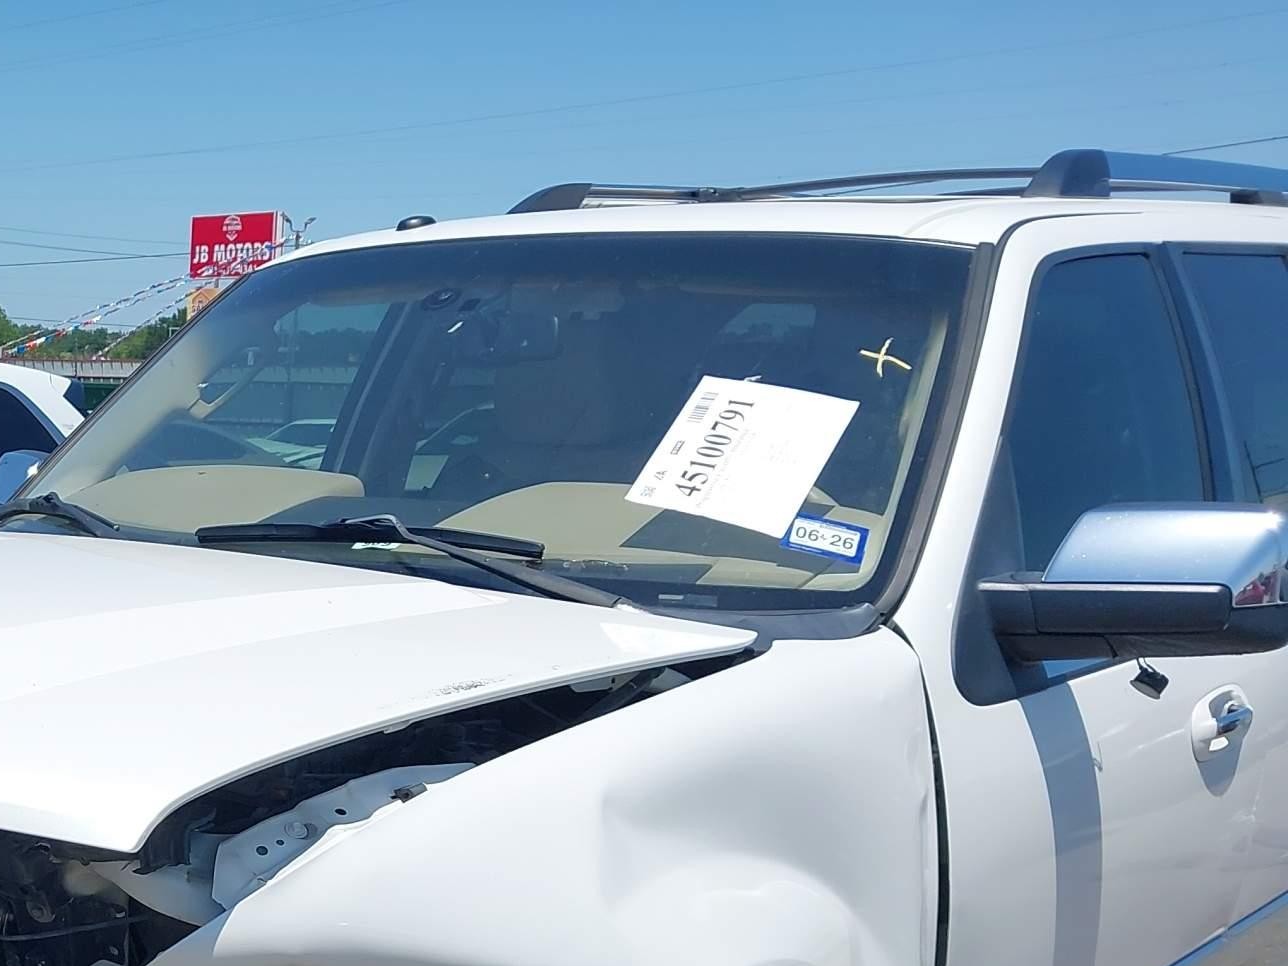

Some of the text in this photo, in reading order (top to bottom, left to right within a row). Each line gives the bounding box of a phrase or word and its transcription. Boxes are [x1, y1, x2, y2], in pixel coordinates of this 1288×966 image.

[193, 241, 271, 264] JB MOTORS
[675, 400, 755, 497] 45100791
